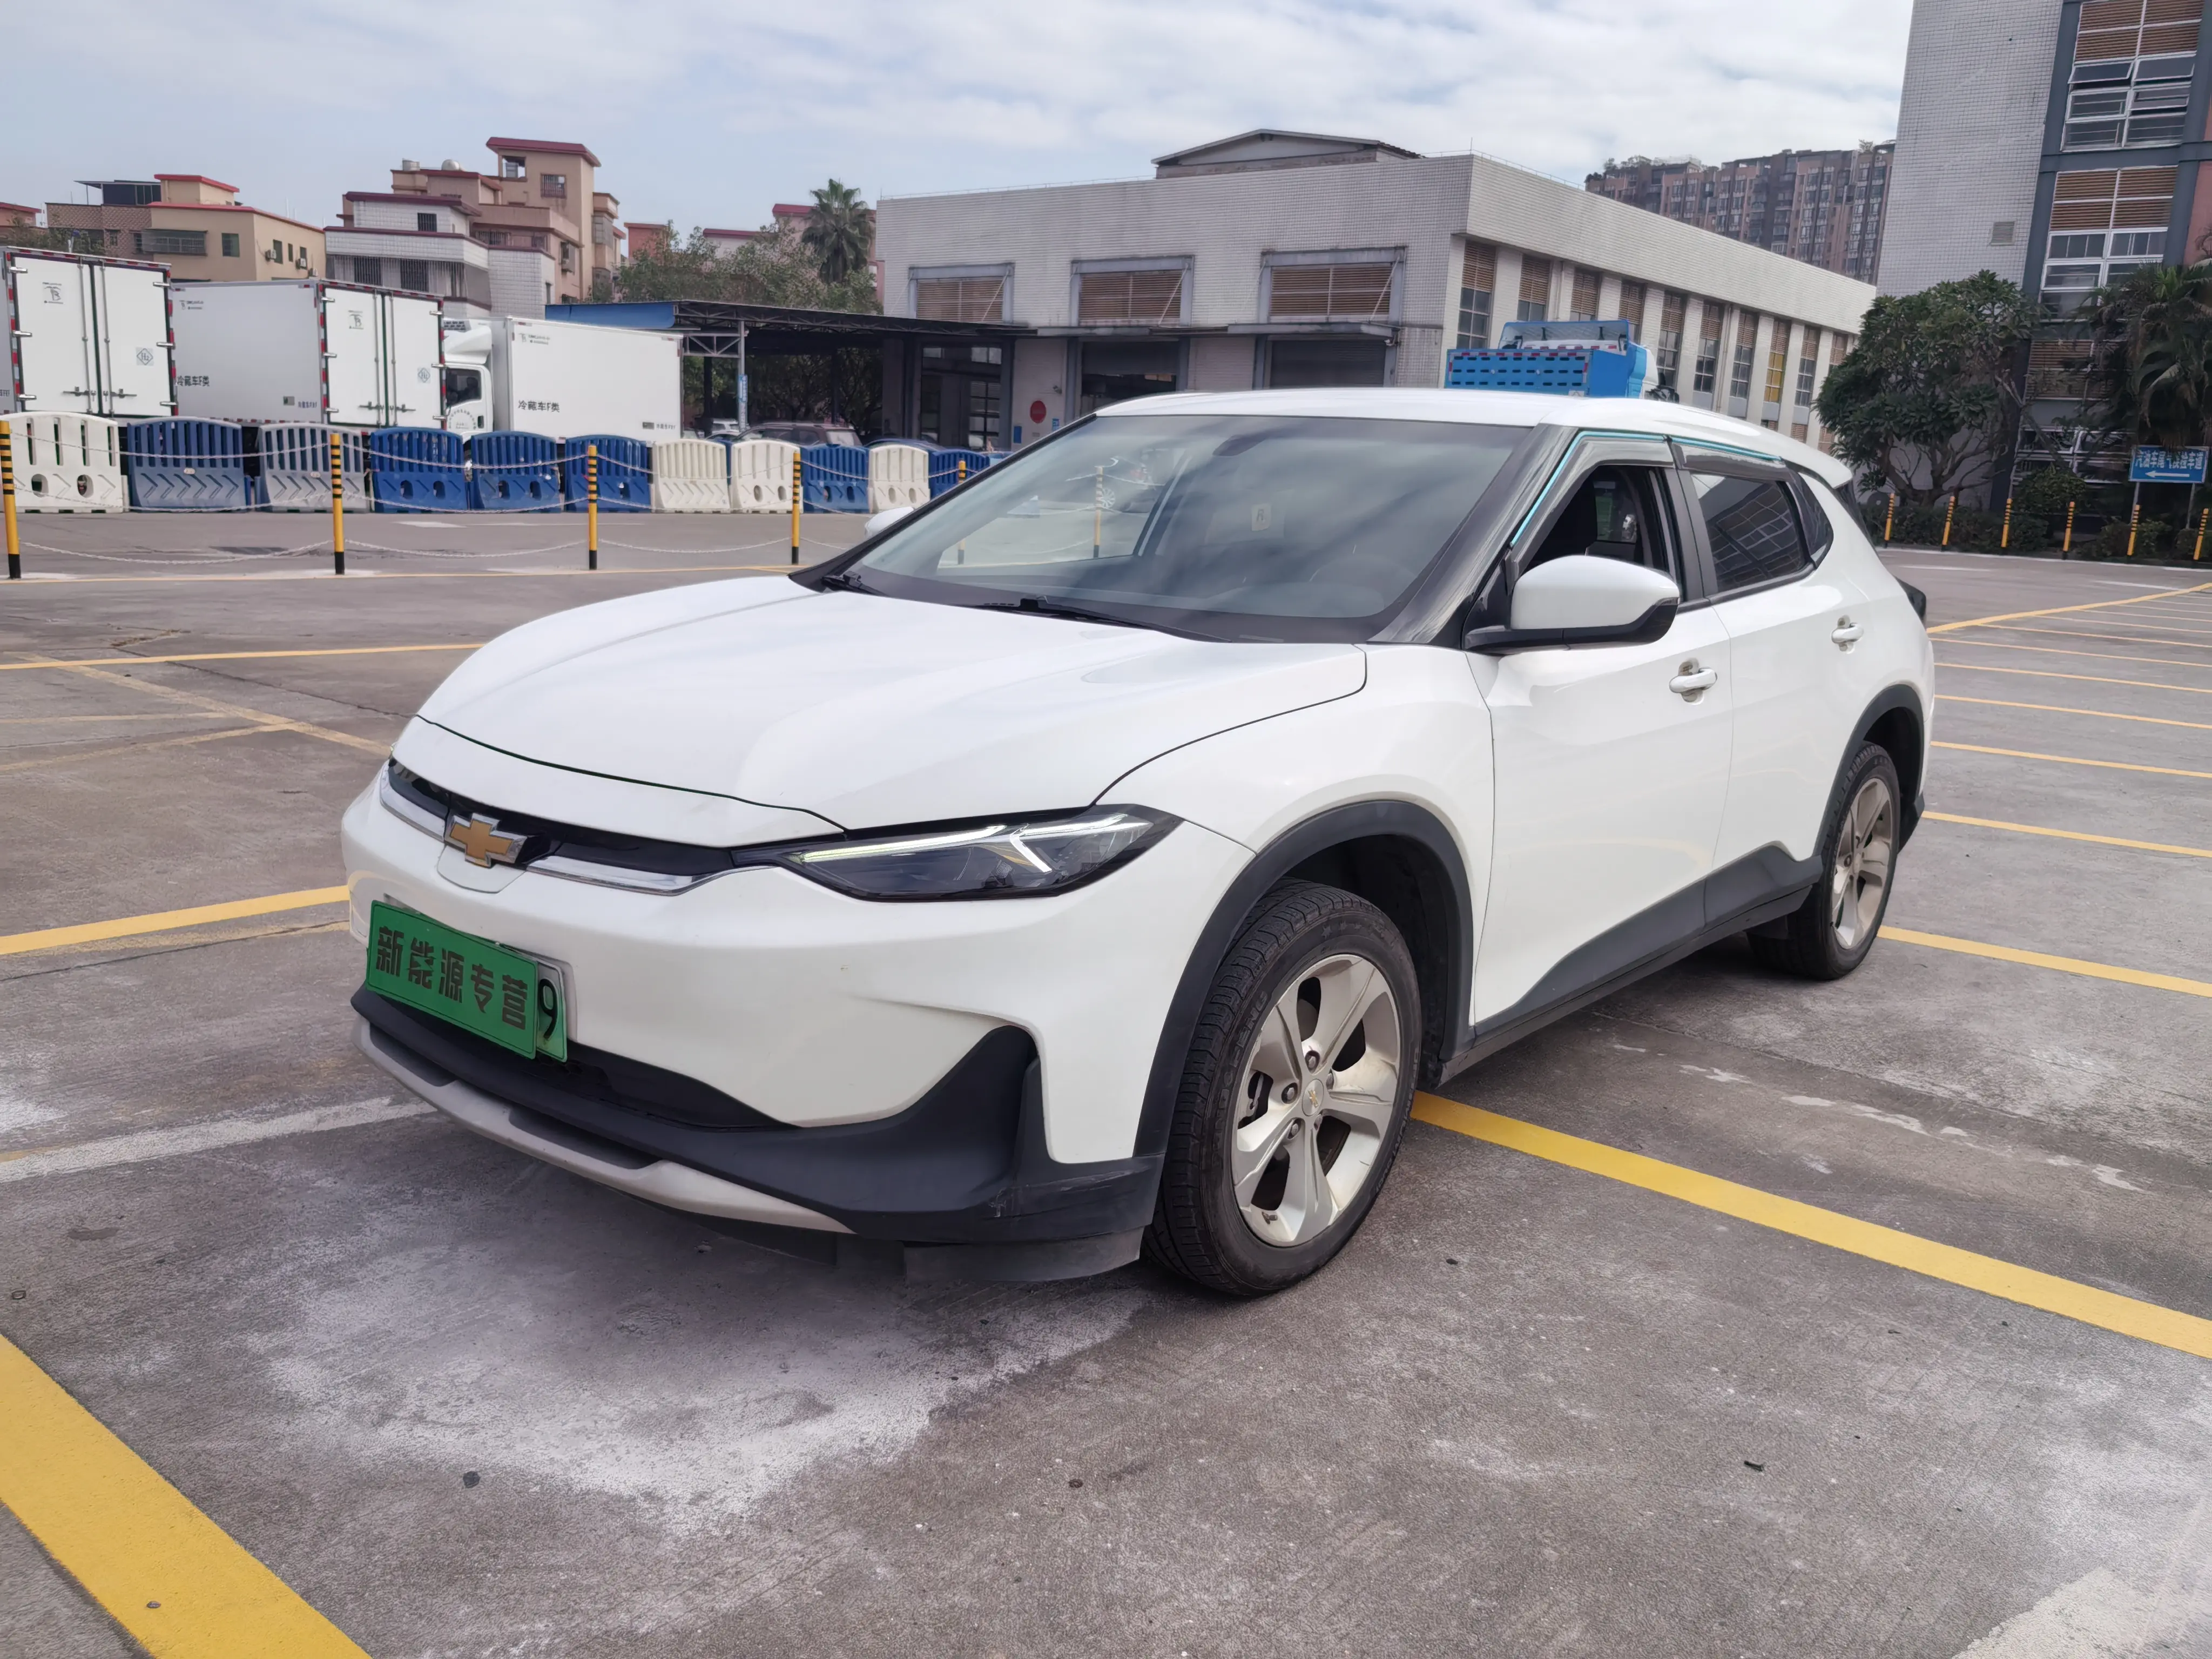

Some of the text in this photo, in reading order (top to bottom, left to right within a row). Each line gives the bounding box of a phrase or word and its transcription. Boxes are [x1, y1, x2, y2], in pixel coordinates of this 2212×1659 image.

[517, 399, 560, 413] 冷藏车F类
[375, 925, 528, 1031] 新能源专营
[539, 978, 559, 1040] 9
